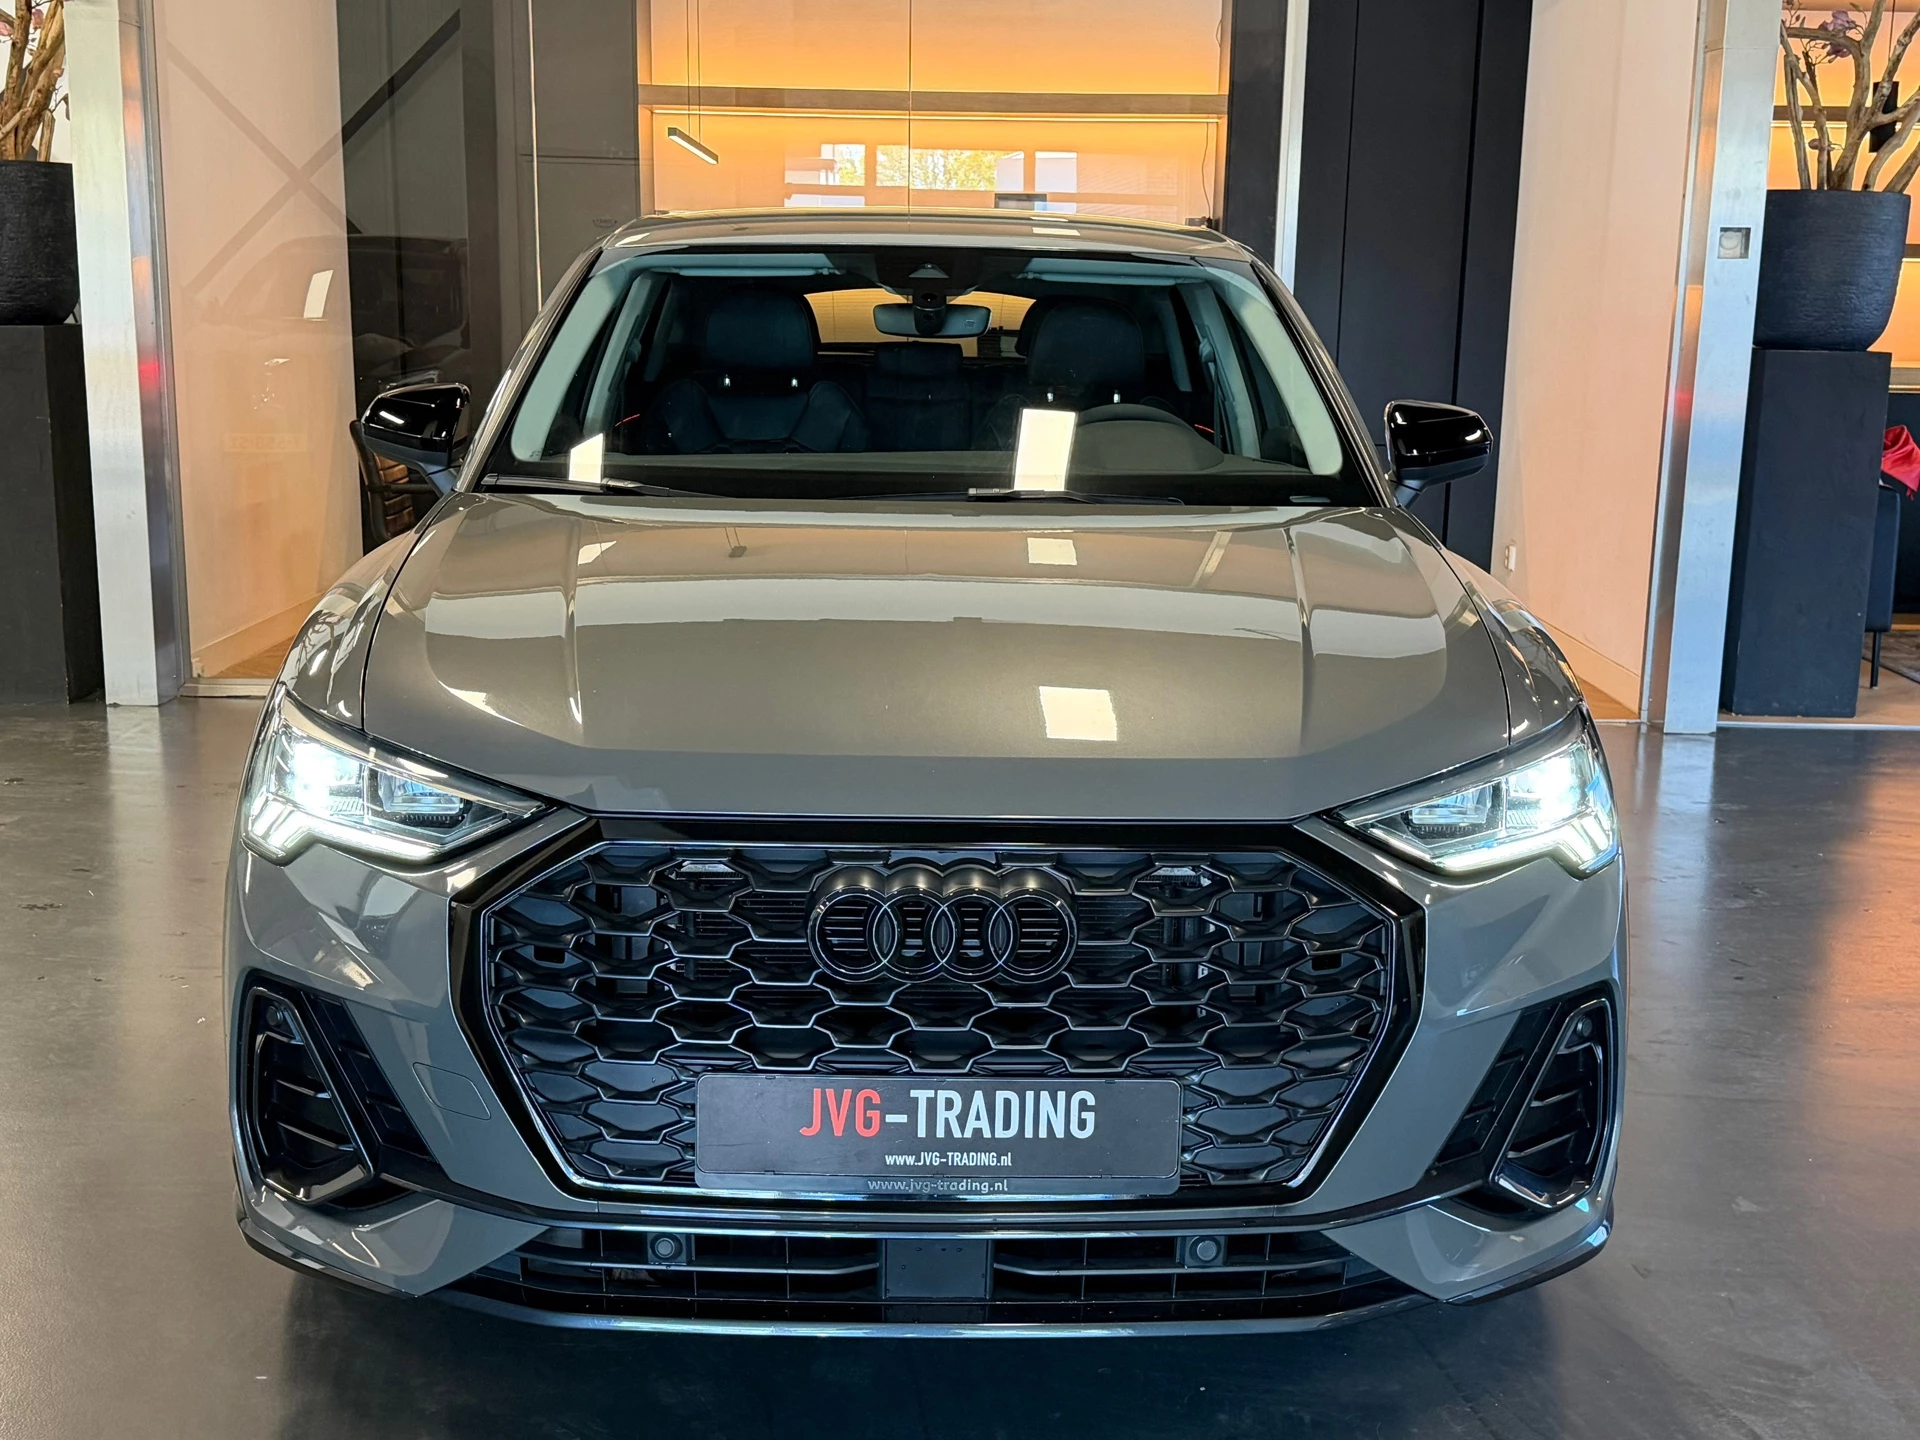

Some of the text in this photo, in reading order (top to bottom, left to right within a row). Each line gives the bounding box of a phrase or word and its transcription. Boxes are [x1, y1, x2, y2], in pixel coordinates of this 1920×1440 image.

[799, 1088, 1096, 1139] JVG-TRADING
[884, 1151, 1012, 1167] www.JVG-TRADING.nl
[867, 1178, 1009, 1194] www.jvg-trading.nl
